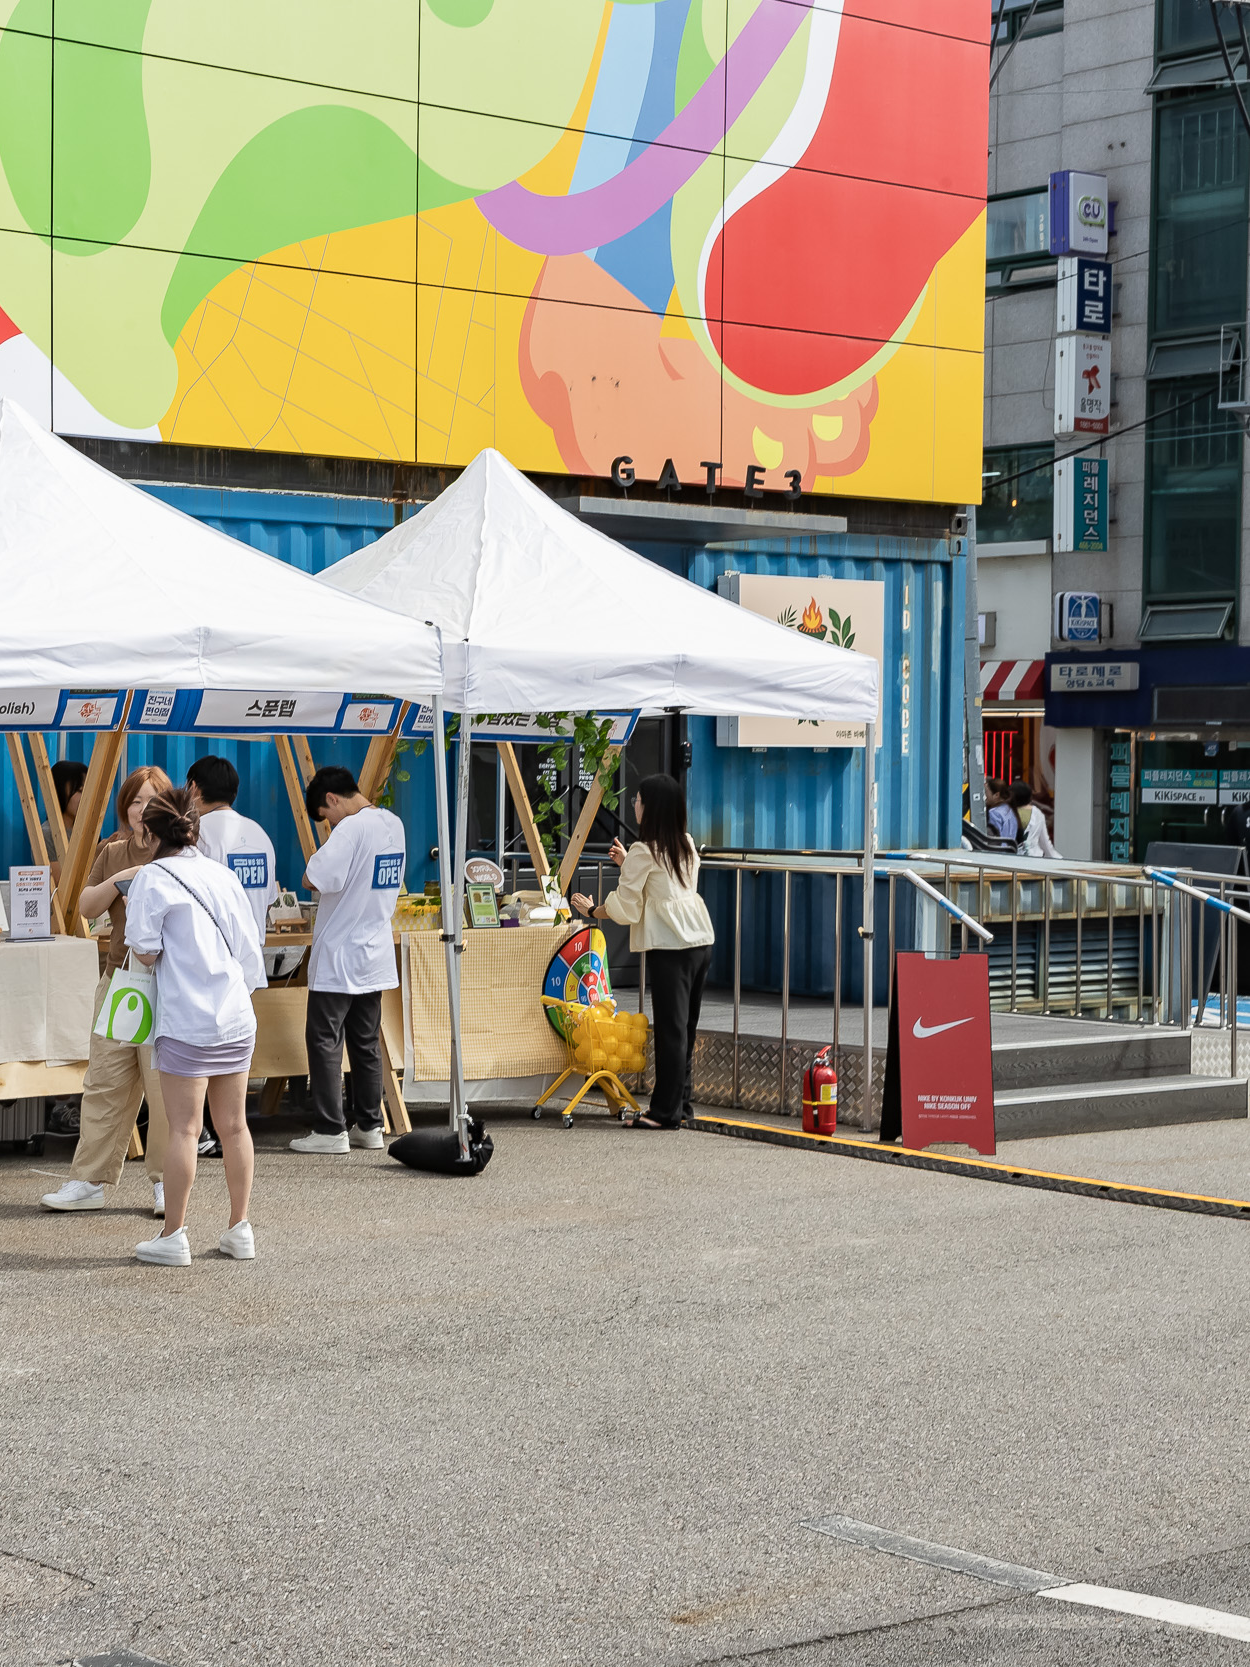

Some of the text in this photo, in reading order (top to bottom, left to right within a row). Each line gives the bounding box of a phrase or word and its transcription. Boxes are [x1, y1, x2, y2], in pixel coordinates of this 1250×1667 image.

[1083, 268, 1106, 324] 타로
[147, 695, 174, 706] 진구네
[145, 706, 171, 717] 편의점
[245, 699, 297, 718] 스푼랩
[1144, 770, 1192, 782] 피플레지던스
[574, 942, 582, 952] 10
[551, 976, 561, 986] 10
